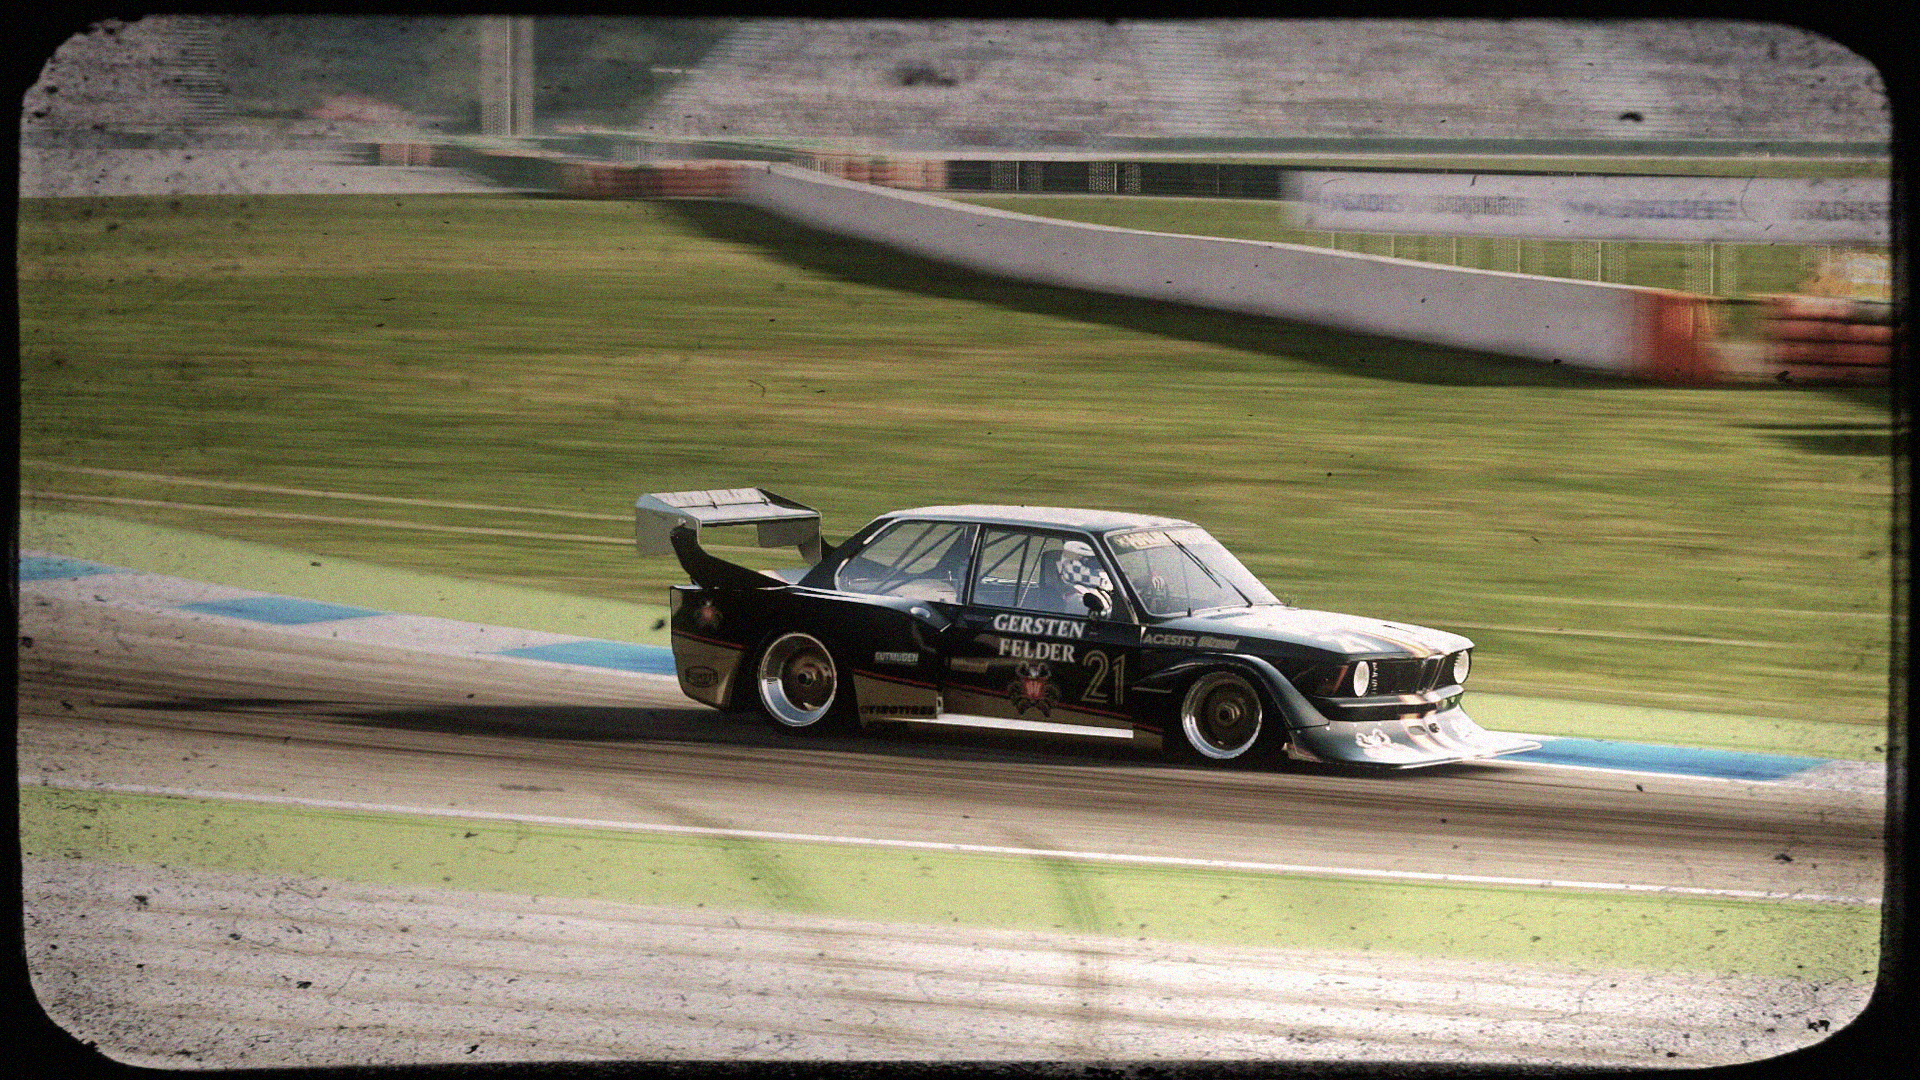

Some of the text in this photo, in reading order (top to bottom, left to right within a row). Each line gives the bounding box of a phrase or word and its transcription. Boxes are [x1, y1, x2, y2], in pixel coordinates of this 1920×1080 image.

[993, 613, 1086, 638] GERSTEN
[999, 638, 1075, 663] FELDER
[1081, 650, 1125, 705] 21
